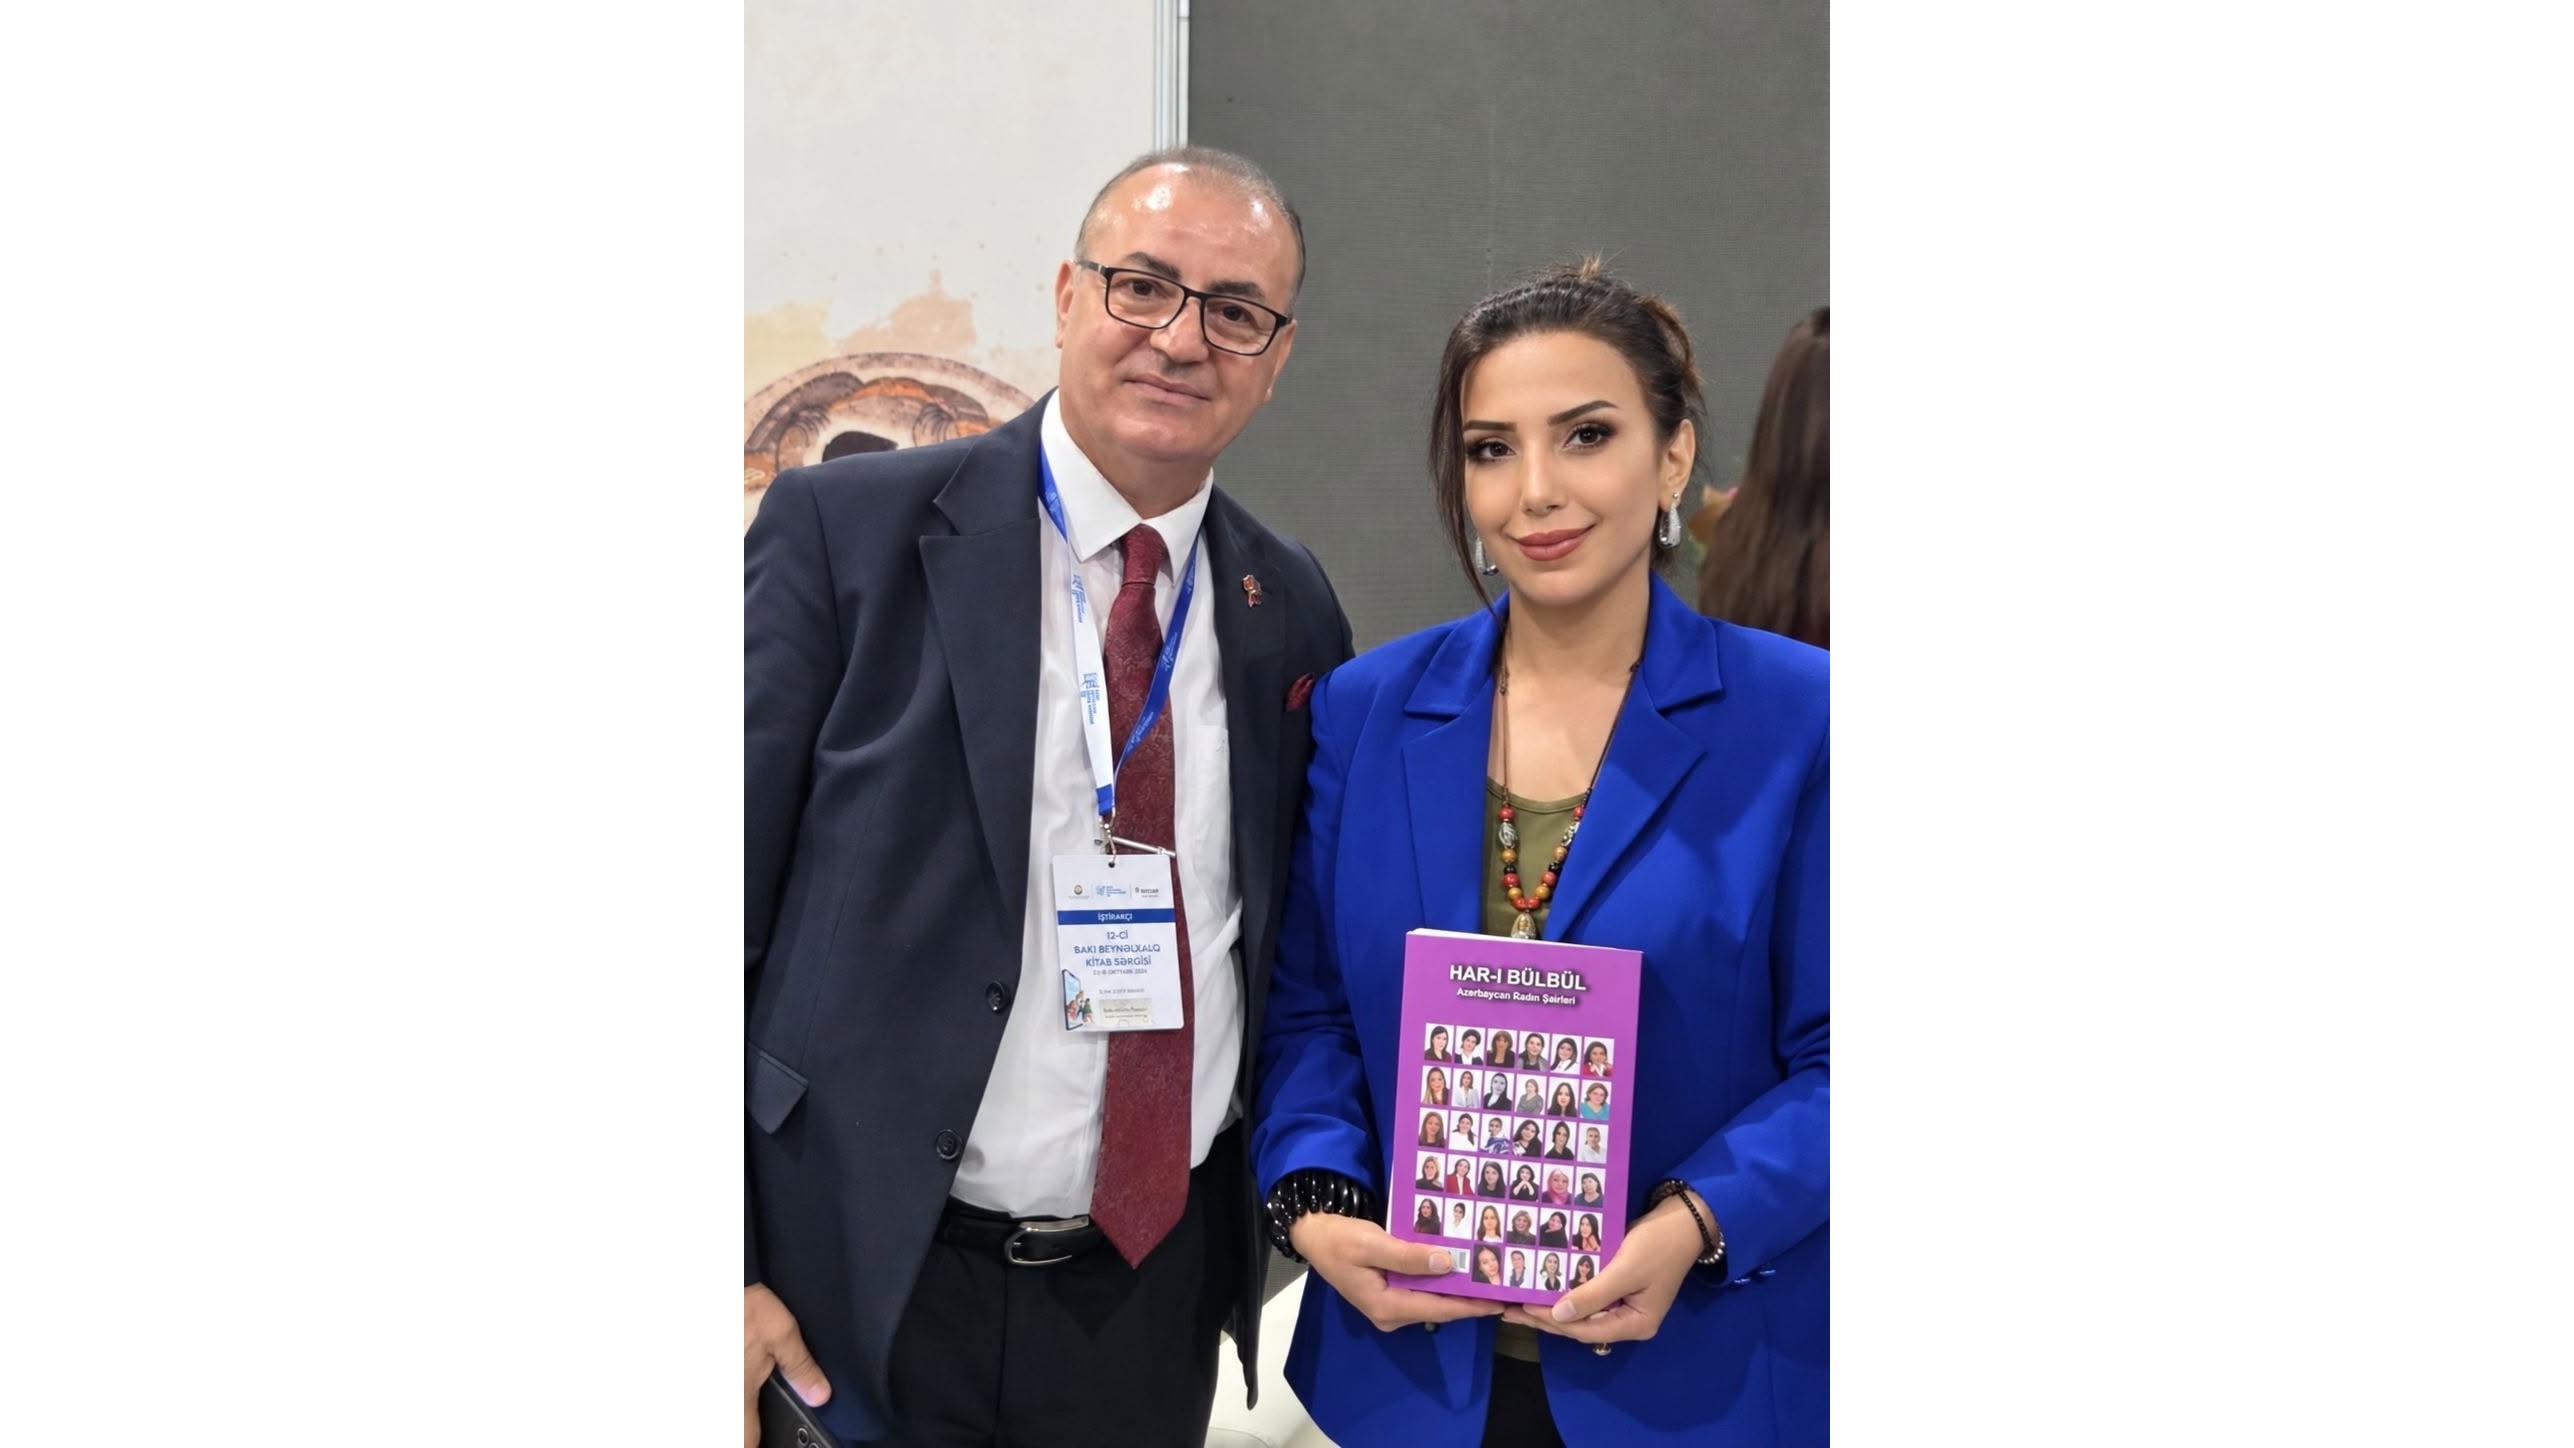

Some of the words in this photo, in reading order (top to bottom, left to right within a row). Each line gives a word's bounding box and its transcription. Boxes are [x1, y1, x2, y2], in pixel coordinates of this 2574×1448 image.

[1106, 929, 1129, 940] 12-Cİ
[1074, 945, 1096, 954] BAKI
[1098, 943, 1161, 954] BEYNƏLXALQ
[1086, 956, 1112, 967] KİTAB
[1449, 965, 1502, 984] HAR-I
[1507, 967, 1587, 991] BÜLBÜL
